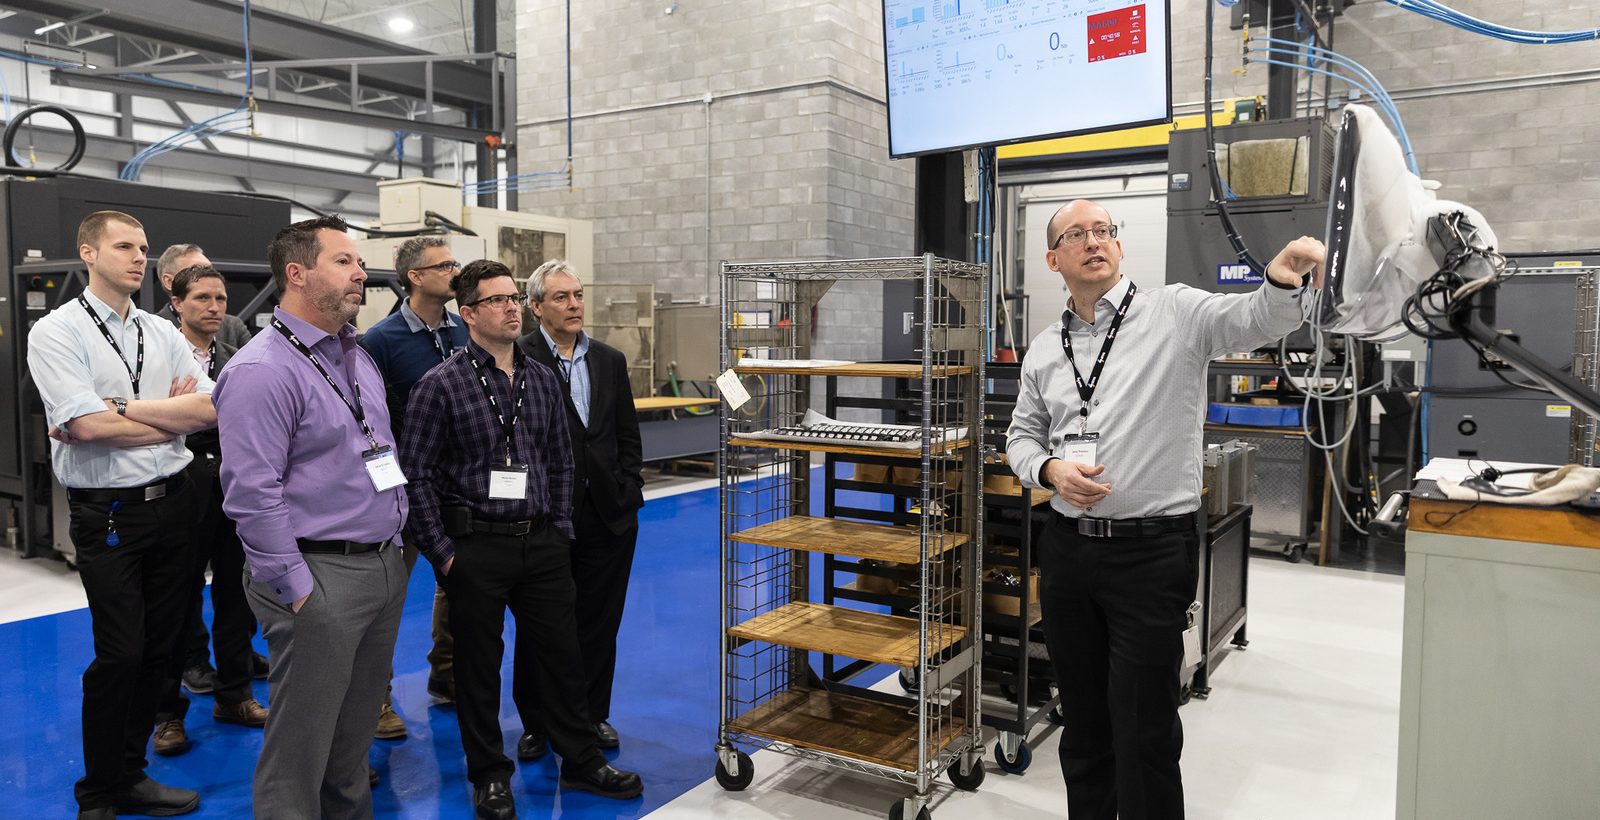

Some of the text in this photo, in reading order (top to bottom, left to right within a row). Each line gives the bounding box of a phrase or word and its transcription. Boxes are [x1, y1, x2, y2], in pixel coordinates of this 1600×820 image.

[1049, 32, 1060, 51] 0
[996, 43, 1007, 61] 0
[1220, 265, 1251, 280] MP
